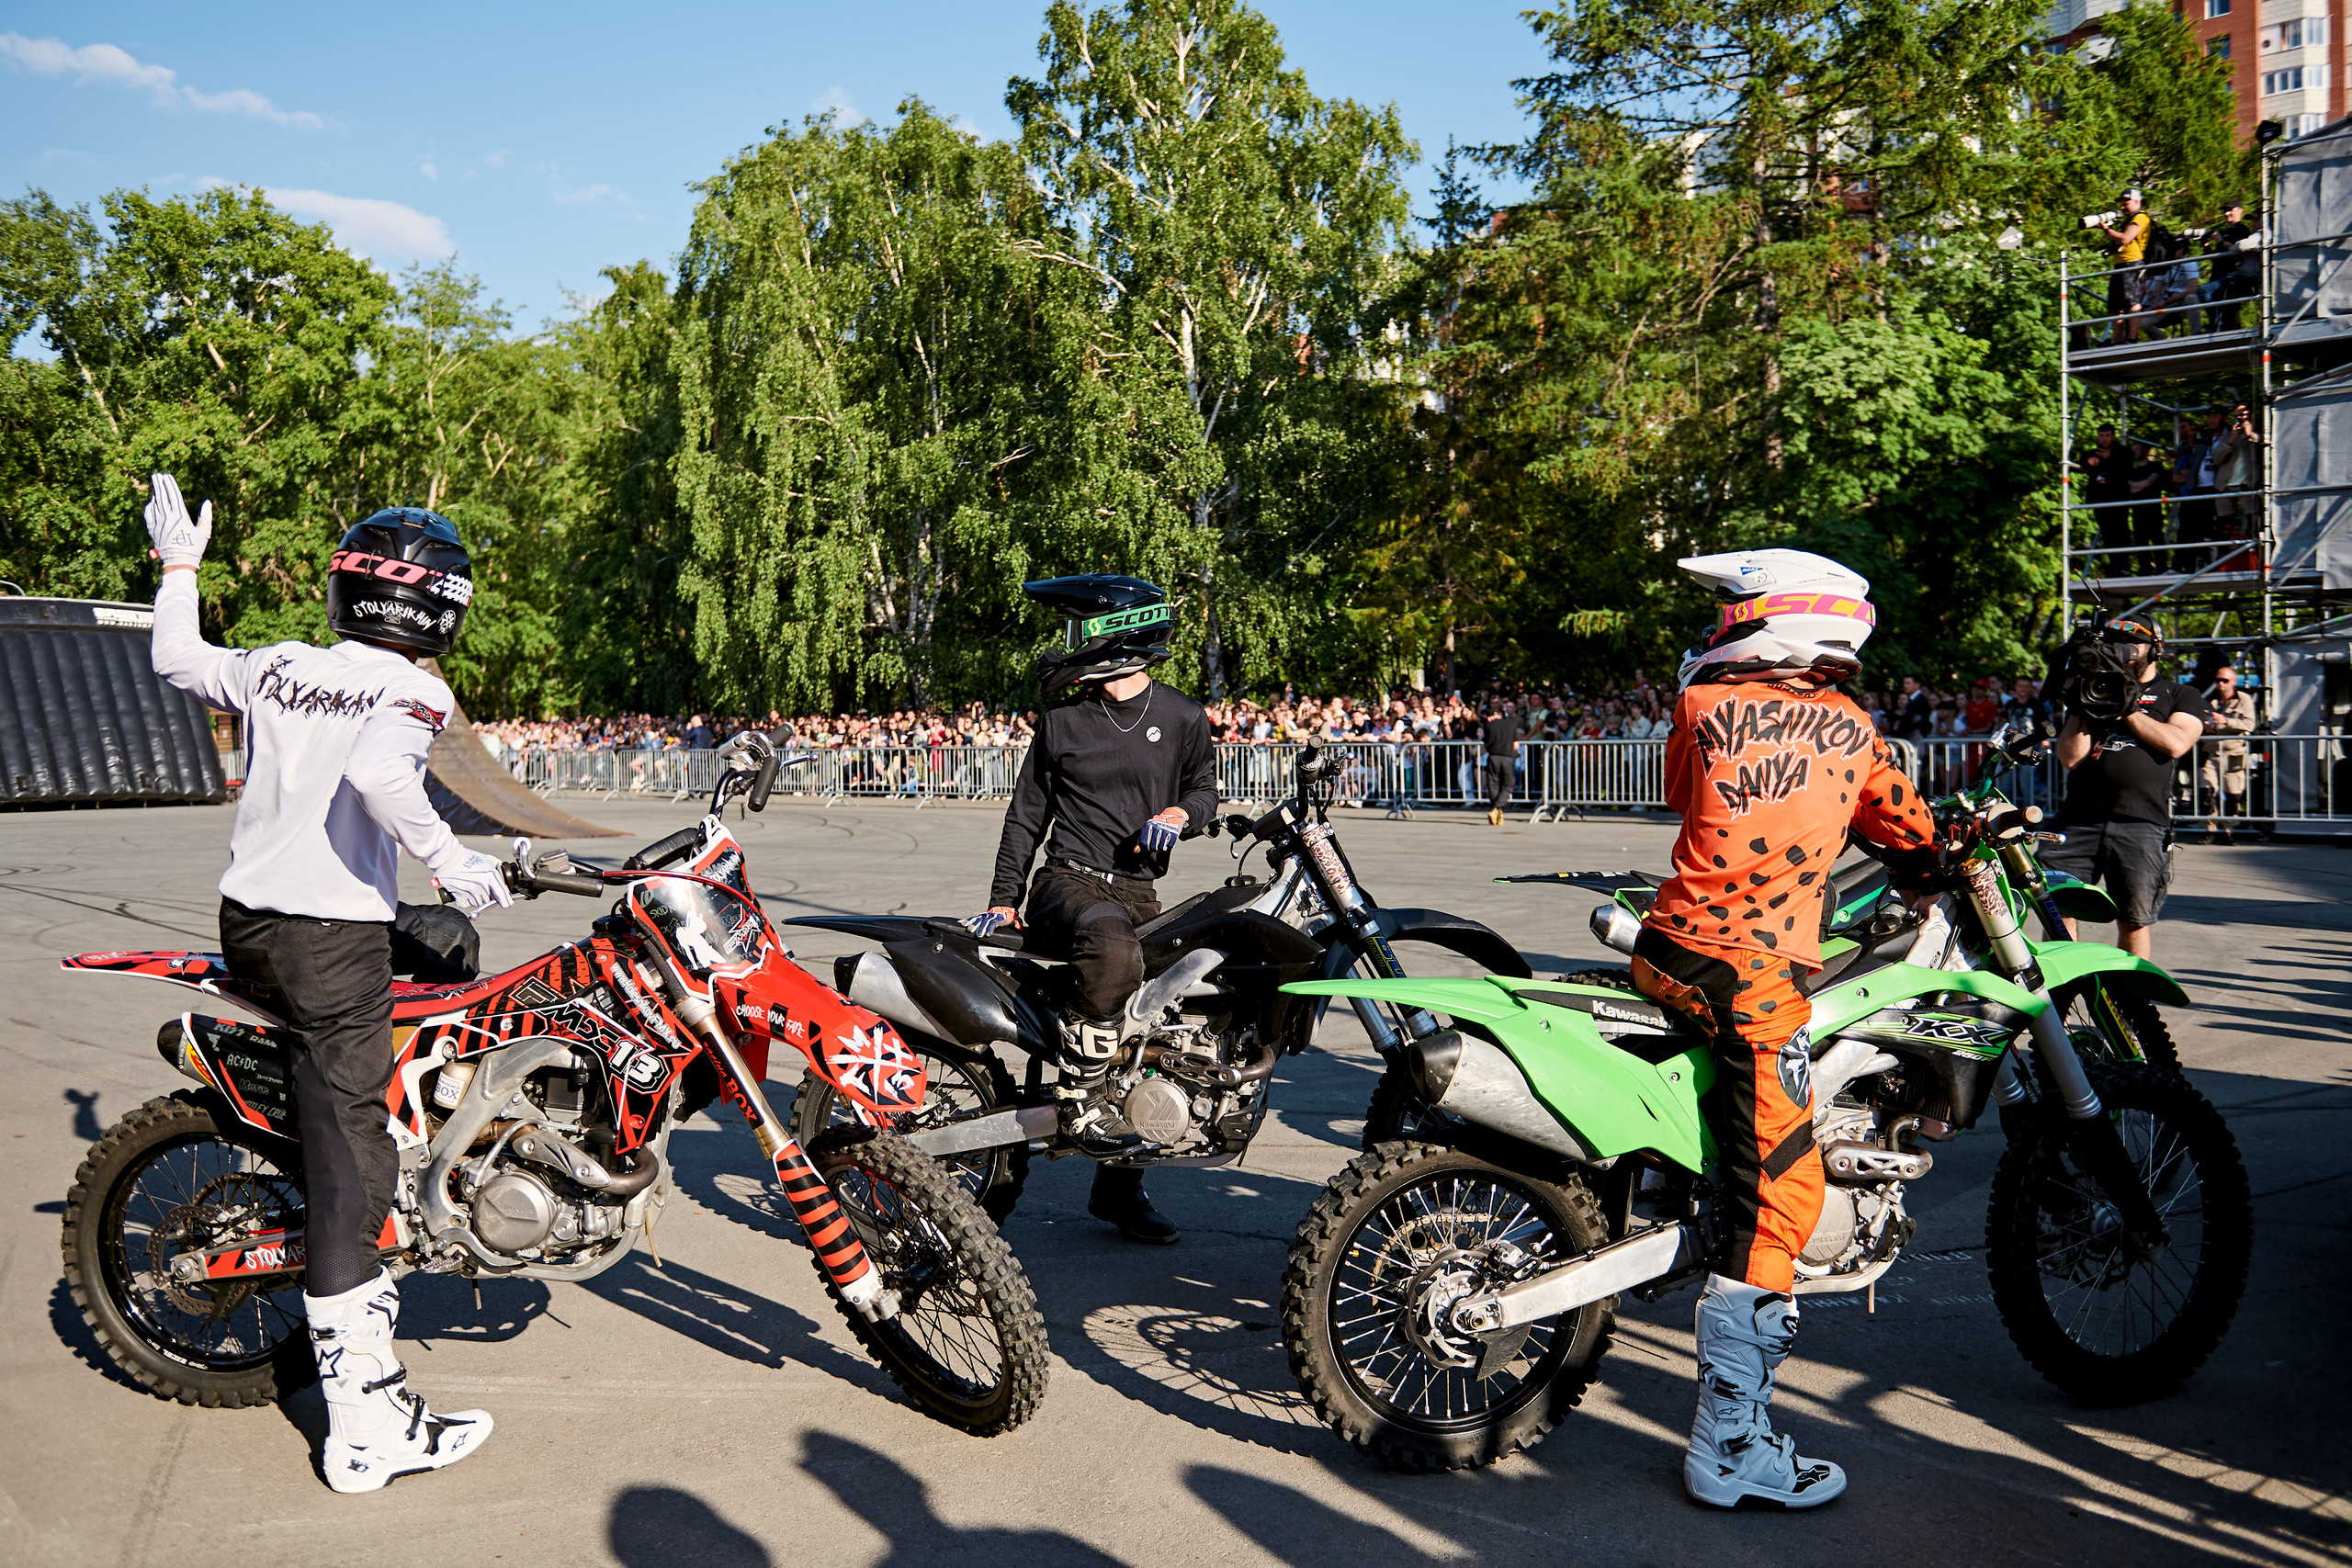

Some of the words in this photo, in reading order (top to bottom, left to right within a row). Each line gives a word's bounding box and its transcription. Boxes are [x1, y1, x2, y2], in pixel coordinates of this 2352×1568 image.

[1103, 607, 1169, 631] SCOTT
[1693, 695, 1874, 777] MYASNIKOV
[1713, 747, 1810, 819] DANYA
[736, 1004, 765, 1020] CHOOSE
[767, 1010, 786, 1027] YOUR
[786, 1020, 806, 1039] FATE
[1592, 1000, 1673, 1029] Kawasaki
[214, 1022, 246, 1037] KISS
[1906, 1017, 2006, 1046] KX
[609, 1040, 668, 1090] 13
[1951, 1050, 1994, 1061] 250F
[435, 1083, 458, 1100] BOX
[728, 1078, 758, 1121] BOX
[1807, 1234, 1846, 1244] awasaki
